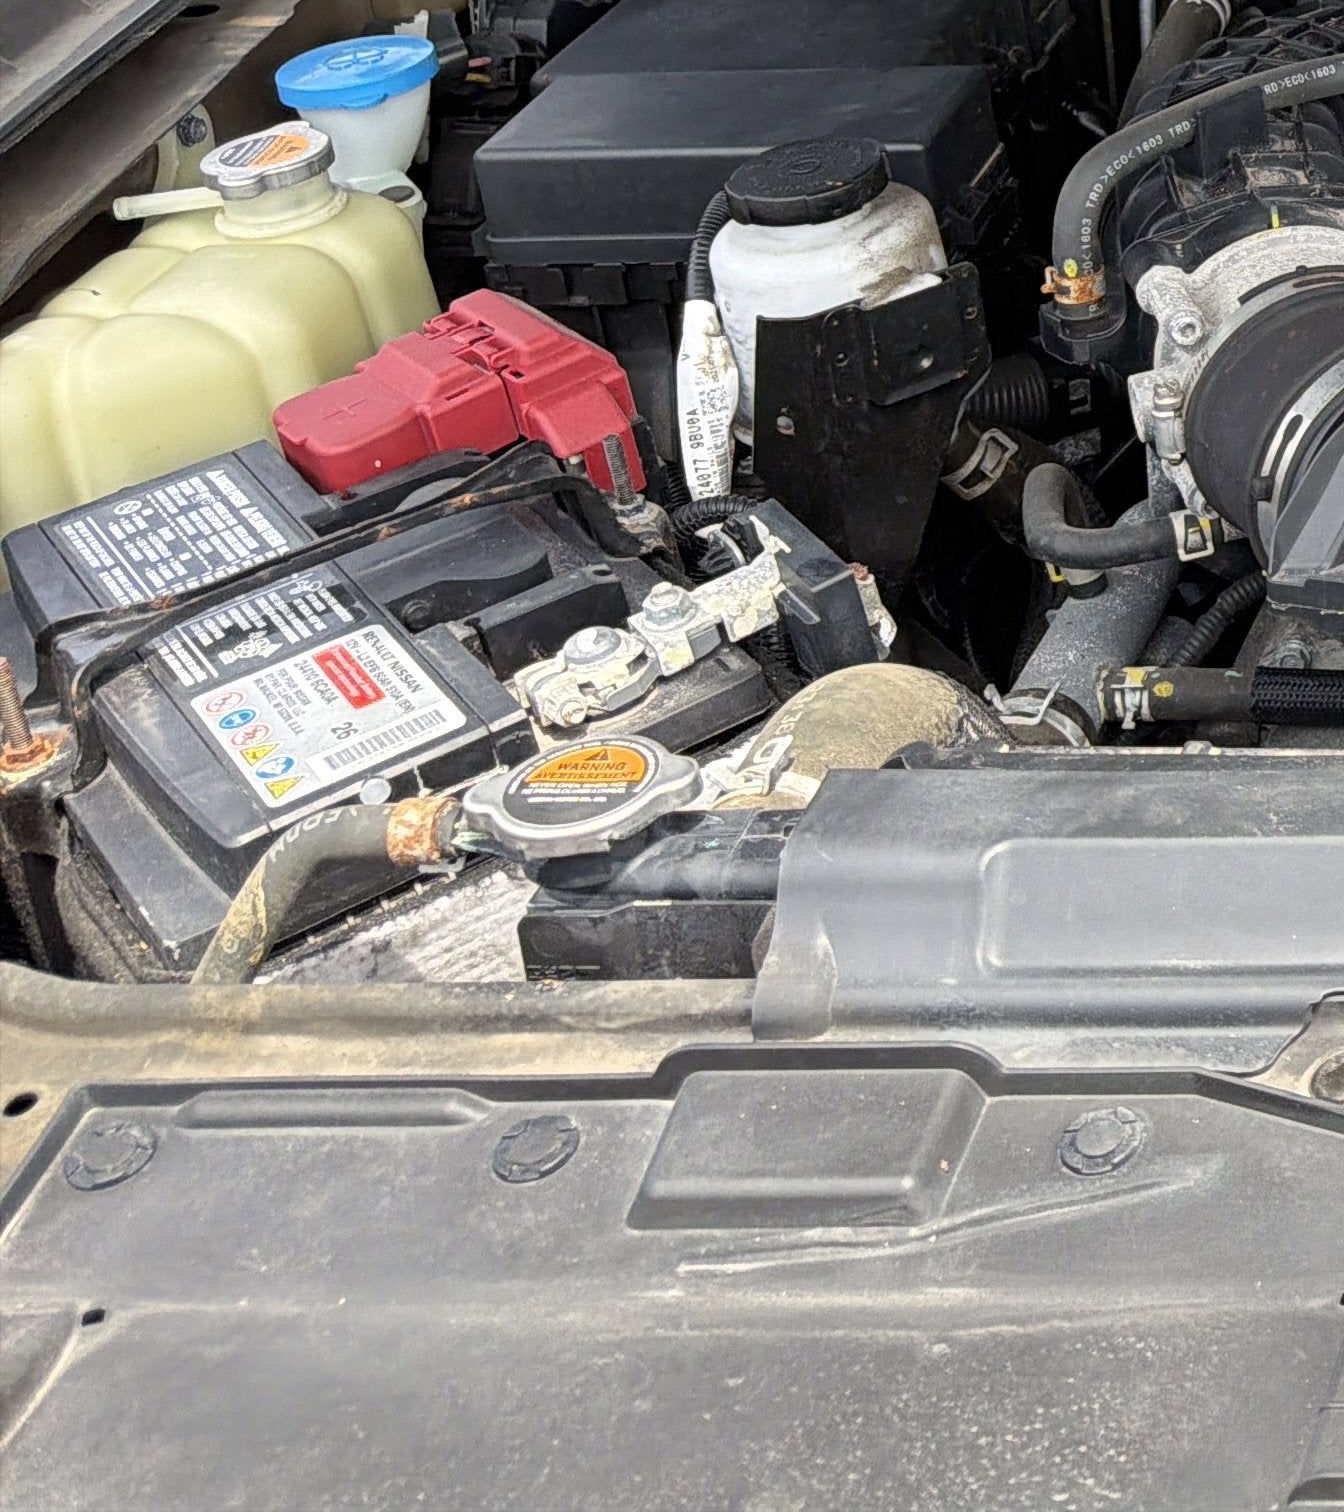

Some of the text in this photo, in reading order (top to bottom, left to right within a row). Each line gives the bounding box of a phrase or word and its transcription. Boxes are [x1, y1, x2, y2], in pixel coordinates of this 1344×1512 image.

[387, 660, 424, 694] NISSAN
[329, 720, 359, 741] 26
[558, 761, 627, 771] WARNING
